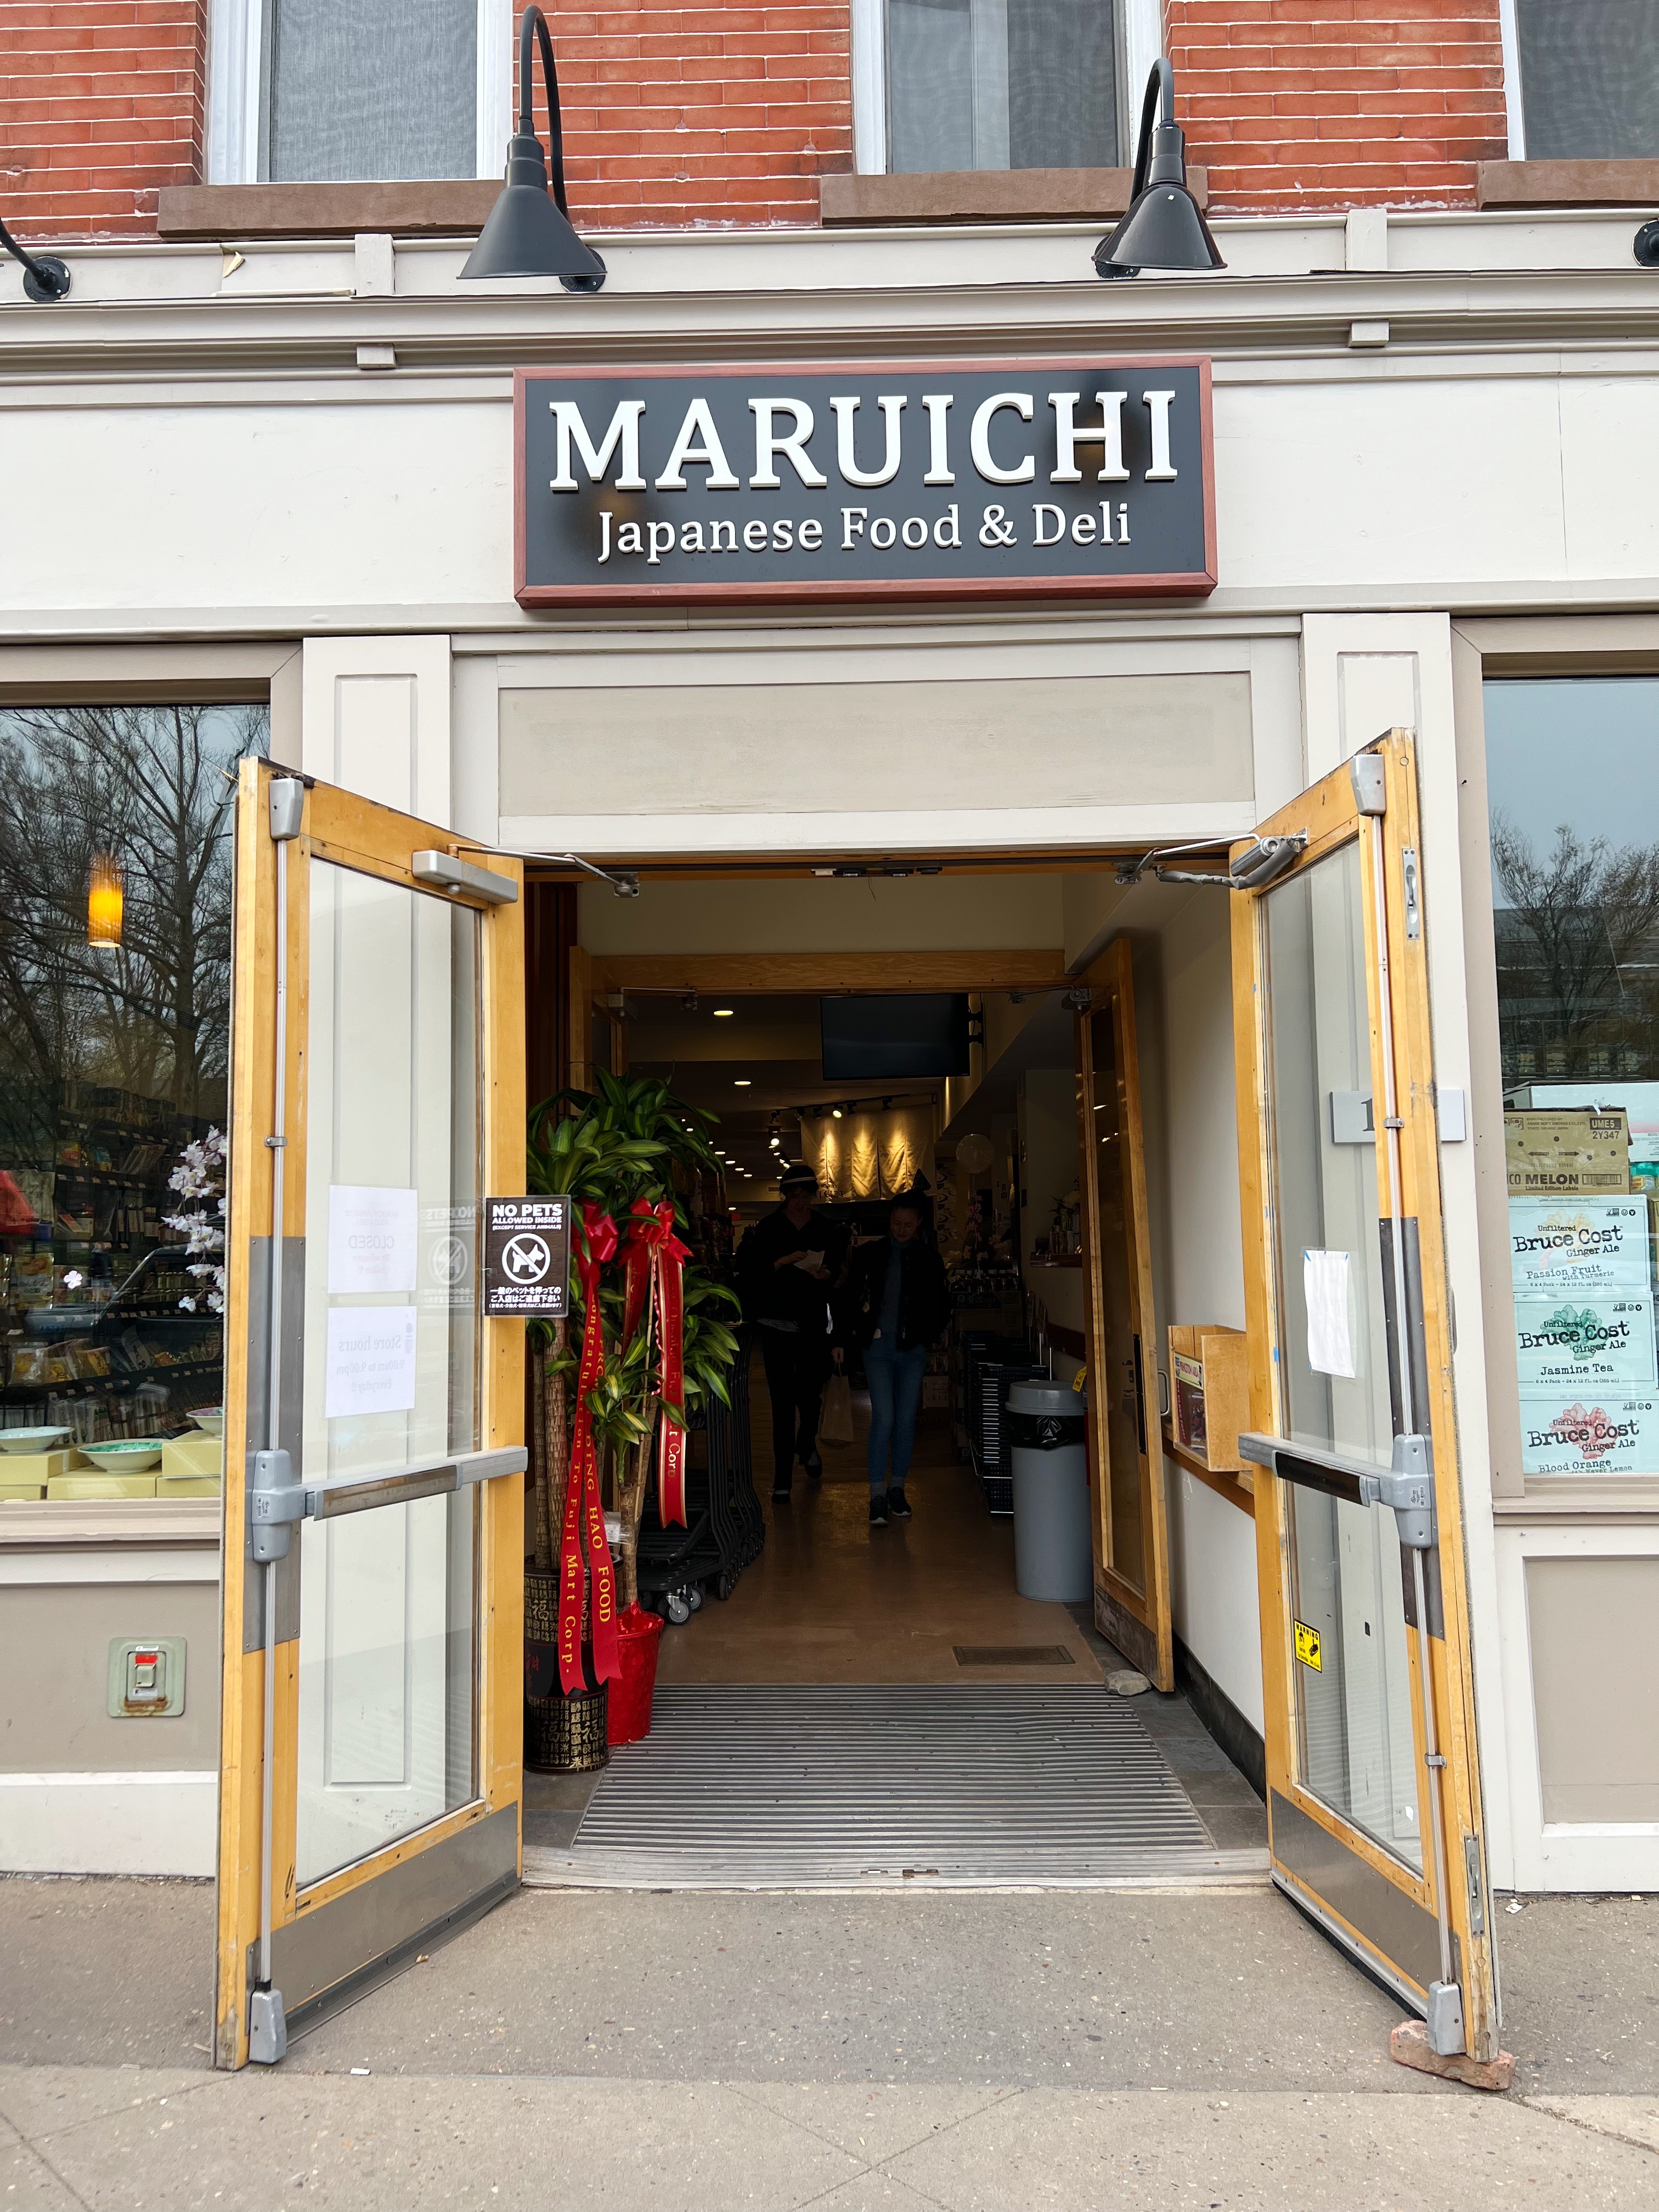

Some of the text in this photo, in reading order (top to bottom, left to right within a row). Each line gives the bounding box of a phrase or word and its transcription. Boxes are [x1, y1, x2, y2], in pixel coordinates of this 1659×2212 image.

[549, 389, 1178, 492] MARUICHI
[599, 501, 1132, 565] Japanese Food & Deli
[1592, 1119, 1615, 1128] UME5
[1592, 1131, 1620, 1139] 2Y347
[1525, 1173, 1579, 1185] MELON
[493, 1203, 563, 1217] NO PETS
[1513, 1225, 1623, 1252] Bruce Cost
[1566, 1244, 1620, 1257] Ginger Ale
[1527, 1265, 1601, 1279] Passion Fruit
[1580, 1271, 1614, 1279] Turmeric
[490, 1286, 562, 1295] 一般のペットを伴っての
[490, 1295, 561, 1303] ご入店はご遠慮下さい
[1519, 1321, 1630, 1348] Bruce Cost
[1572, 1340, 1626, 1353] Ginger Ale
[576, 1293, 597, 1448] ongratulation
[1541, 1363, 1613, 1375] Jasmine Tea
[1527, 1419, 1639, 1447] Bruce Cost
[1582, 1438, 1635, 1452] Ginger Ale
[573, 1462, 580, 1483] To
[1538, 1459, 1611, 1473] Blood Orange
[566, 1498, 577, 1541] Fuji
[589, 1506, 603, 1549] HAO
[597, 1565, 611, 1623] FOOD
[566, 1554, 578, 1601] Mart
[1296, 1623, 1318, 1640] WARNING
[561, 1616, 576, 1673] Corp.
